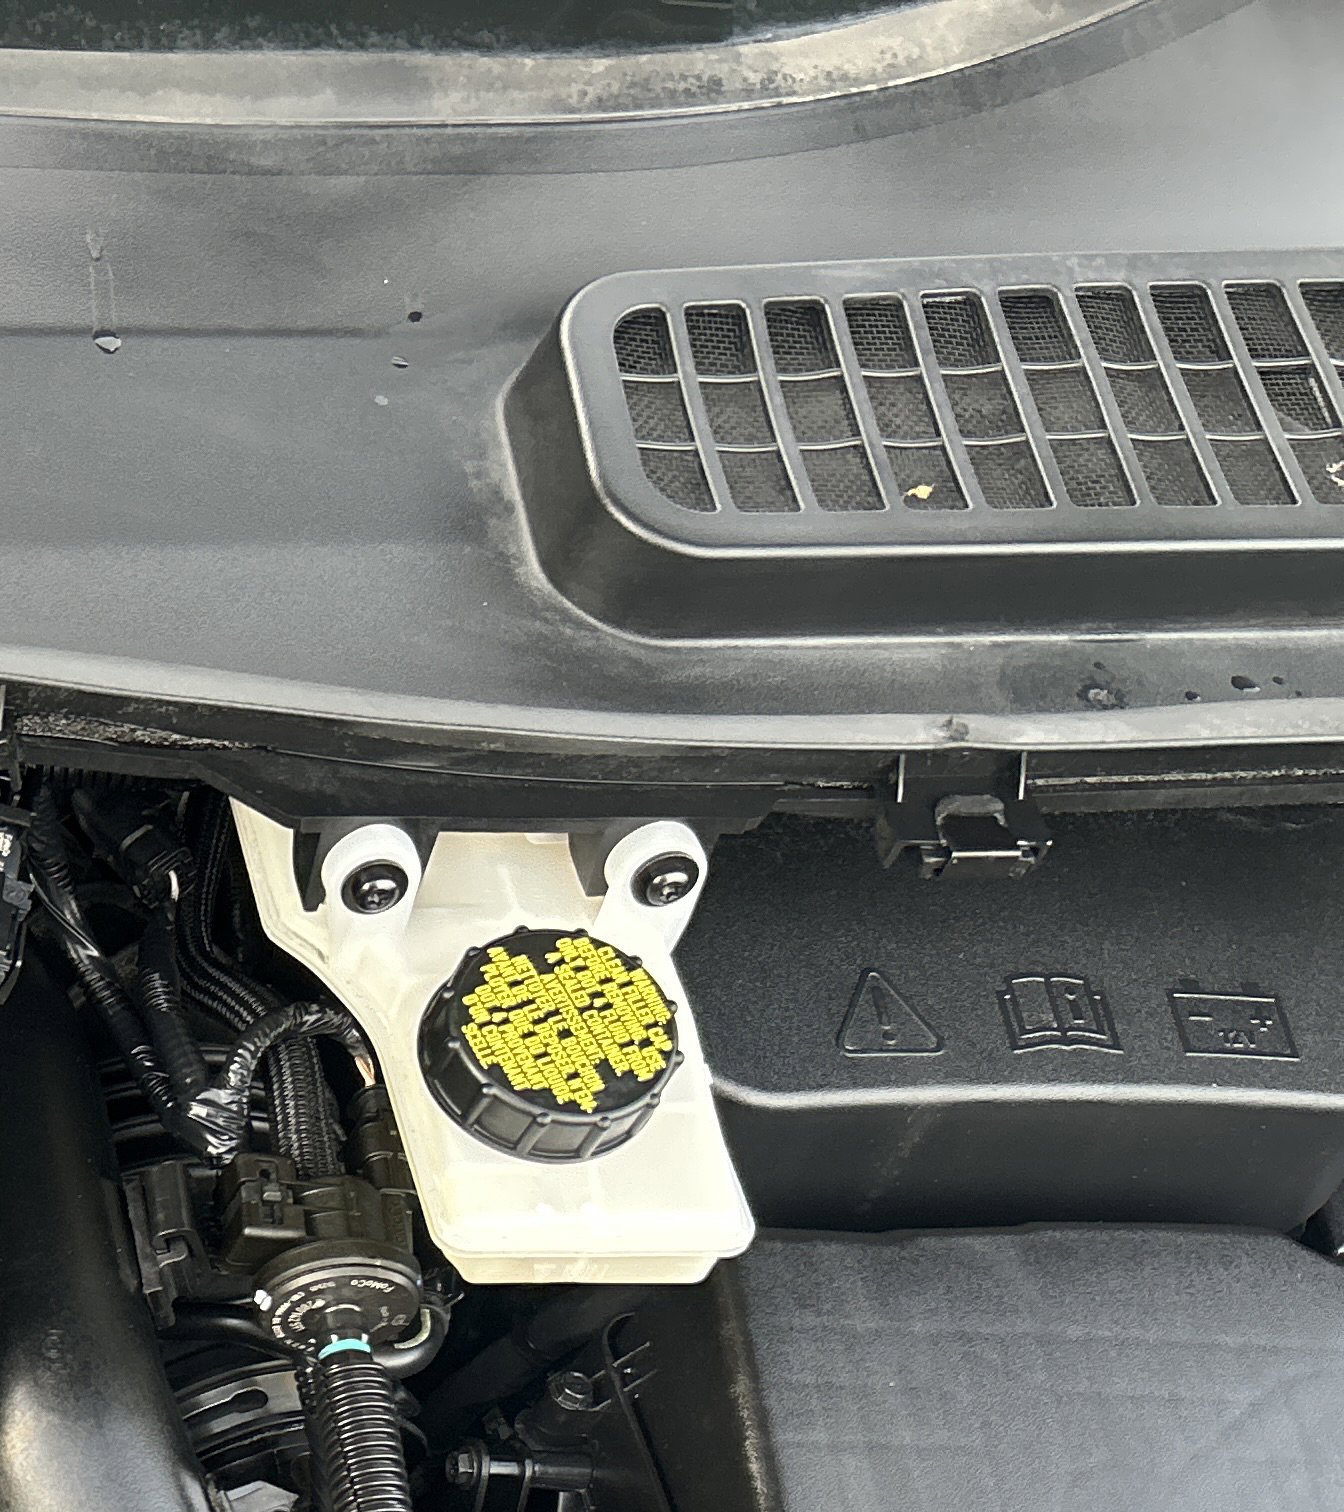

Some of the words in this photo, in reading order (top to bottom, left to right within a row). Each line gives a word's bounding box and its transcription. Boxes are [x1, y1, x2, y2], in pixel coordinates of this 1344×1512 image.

[489, 949, 522, 984] AVANT
[509, 983, 533, 1004] DE
[521, 1003, 544, 1022] LE
[546, 949, 565, 961] A
[554, 962, 591, 1010] SEALED
[510, 955, 557, 1014] NETTOYER
[547, 1015, 569, 1035] LE
[558, 1036, 602, 1094] BOUCHON
[558, 937, 587, 970] ONLY
[596, 1008, 631, 1046] FLUID
[618, 1044, 652, 1081] FROM
[573, 937, 613, 982] BEFORE
[637, 1045, 663, 1073] USE
[597, 945, 633, 985] CLEAN
[620, 984, 657, 1027] FILLER
[644, 1027, 670, 1054] CAP
[479, 1024, 531, 1091] CONTENANT
[495, 1022, 549, 1090] PROVENANT
[505, 1009, 535, 1036] QUE
[533, 1056, 575, 1104] LIQUIDE
[578, 1009, 631, 1076] CONTAINER.
[350, 1279, 395, 1293] FoMoCo
